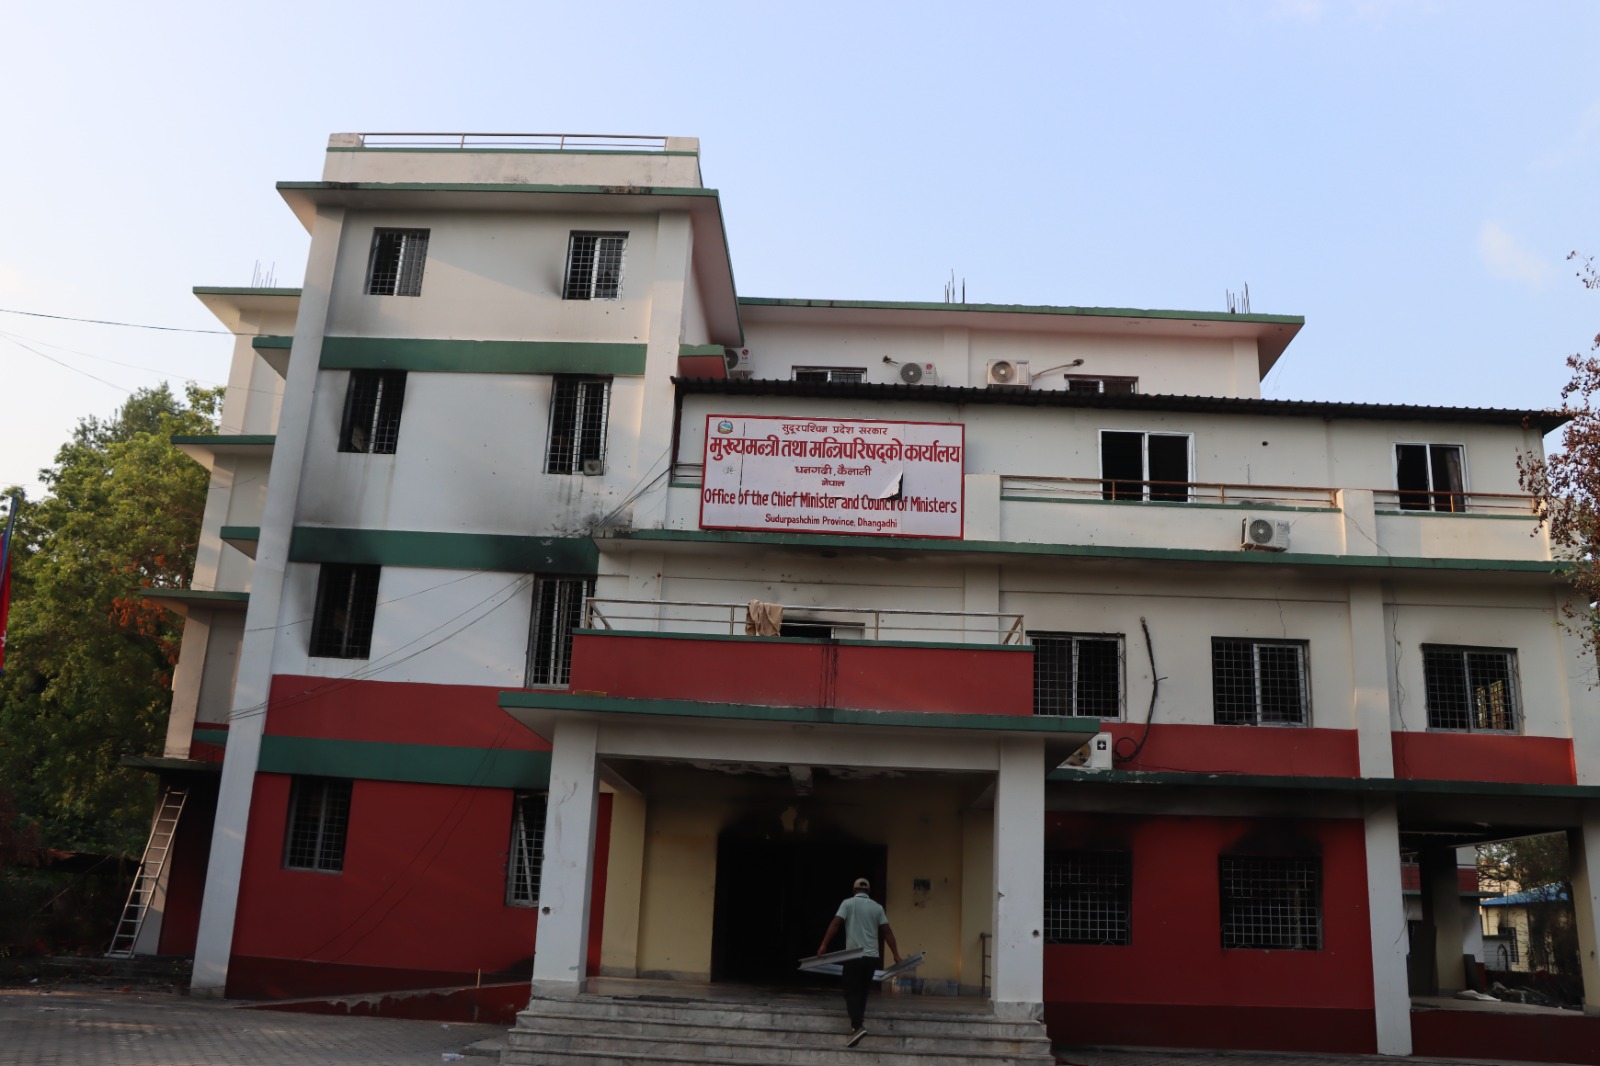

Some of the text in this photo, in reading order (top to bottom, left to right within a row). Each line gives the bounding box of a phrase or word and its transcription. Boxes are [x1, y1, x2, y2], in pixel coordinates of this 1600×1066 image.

[832, 424, 854, 434] प्रदेश
[859, 427, 888, 435] सरकार
[709, 434, 780, 461] मुख्यमन्त्री
[781, 440, 808, 457] तथा
[904, 440, 961, 463] कार्यालय
[837, 464, 872, 476] कैलाली
[821, 478, 845, 487] नेपाल
[704, 488, 736, 505] Office
[738, 490, 750, 506] of
[750, 490, 769, 507] the
[771, 491, 797, 508] Chief
[800, 492, 838, 510] Minister
[841, 494, 860, 511] and
[897, 496, 908, 512] of
[910, 496, 957, 514] Ministers
[765, 513, 898, 532] Sudurpashchim Province, Dhangadhi
